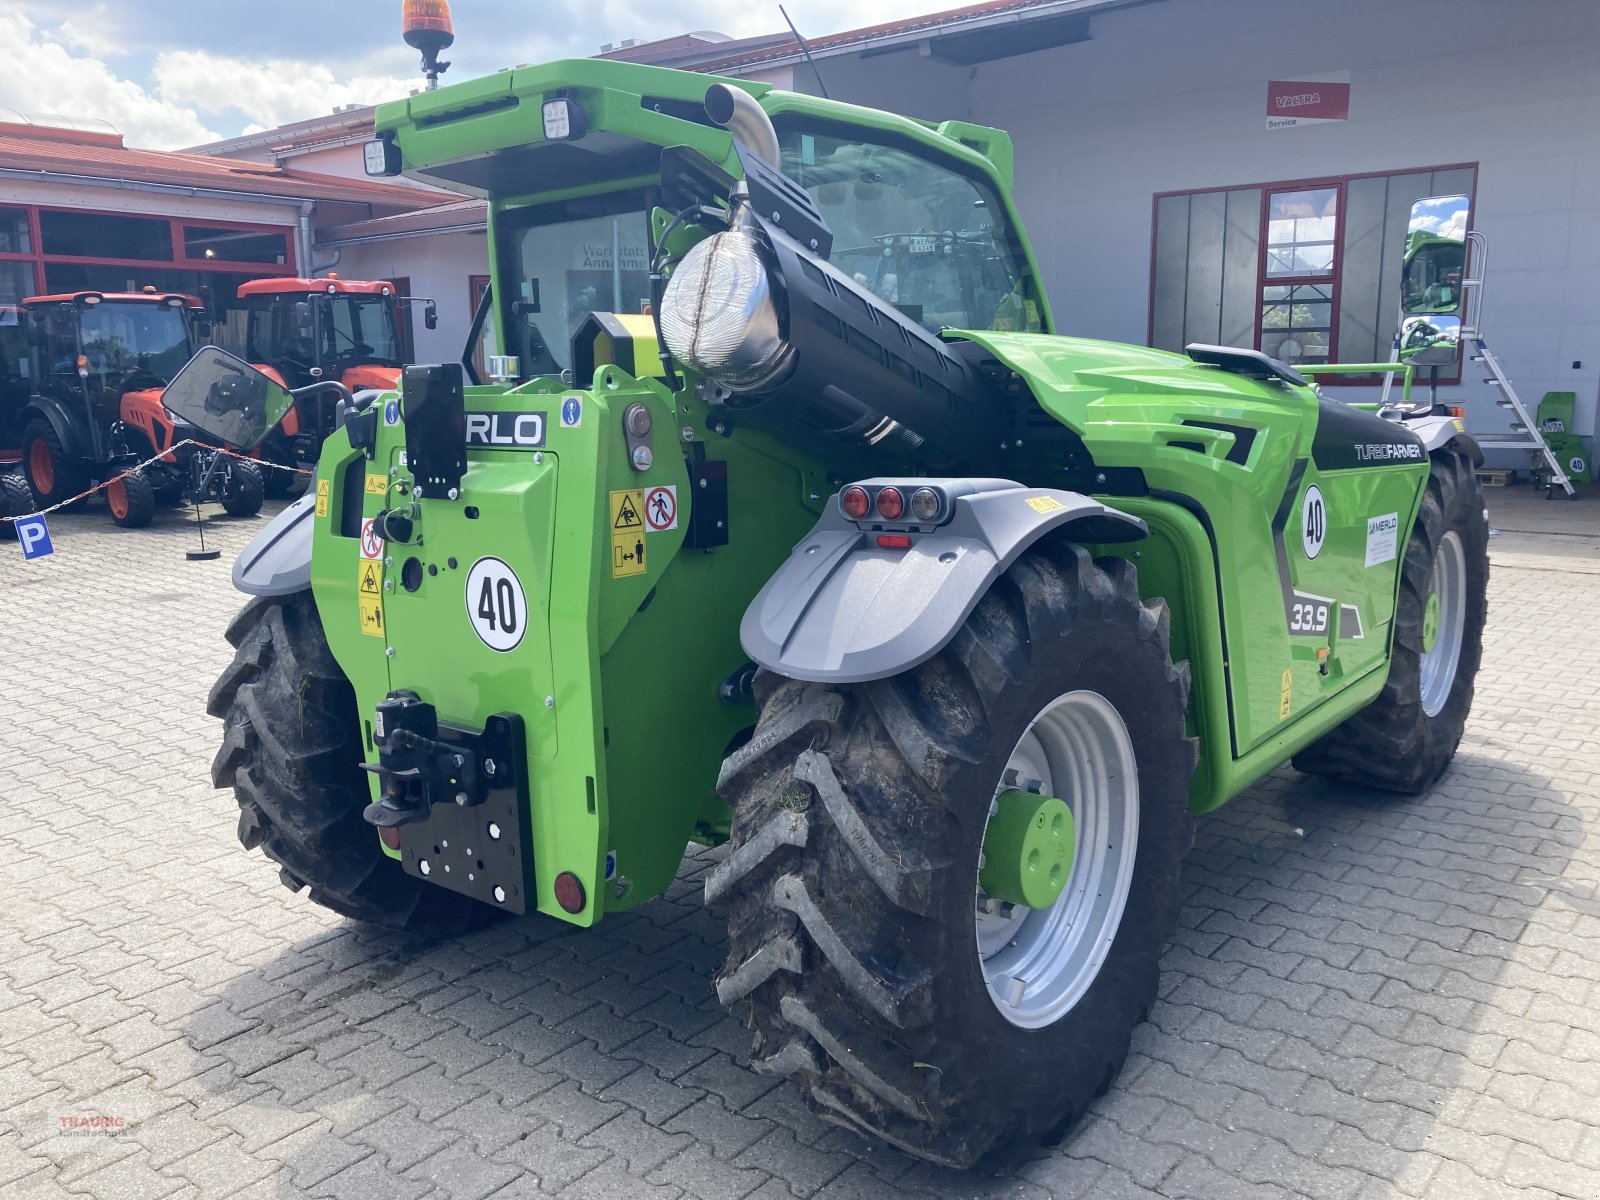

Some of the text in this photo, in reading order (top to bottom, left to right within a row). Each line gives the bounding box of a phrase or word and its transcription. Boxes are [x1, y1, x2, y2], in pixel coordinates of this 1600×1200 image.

[1275, 92, 1321, 109] VALTRA
[1268, 119, 1297, 128] Service
[464, 414, 543, 445] RLO
[1354, 444, 1422, 460] TURBOFARMER
[1572, 460, 1583, 470] 40
[1306, 499, 1323, 545] 40
[1375, 517, 1397, 532] MERLO
[19, 522, 46, 554] P
[478, 576, 517, 634] 40
[1290, 603, 1328, 632] 33.9
